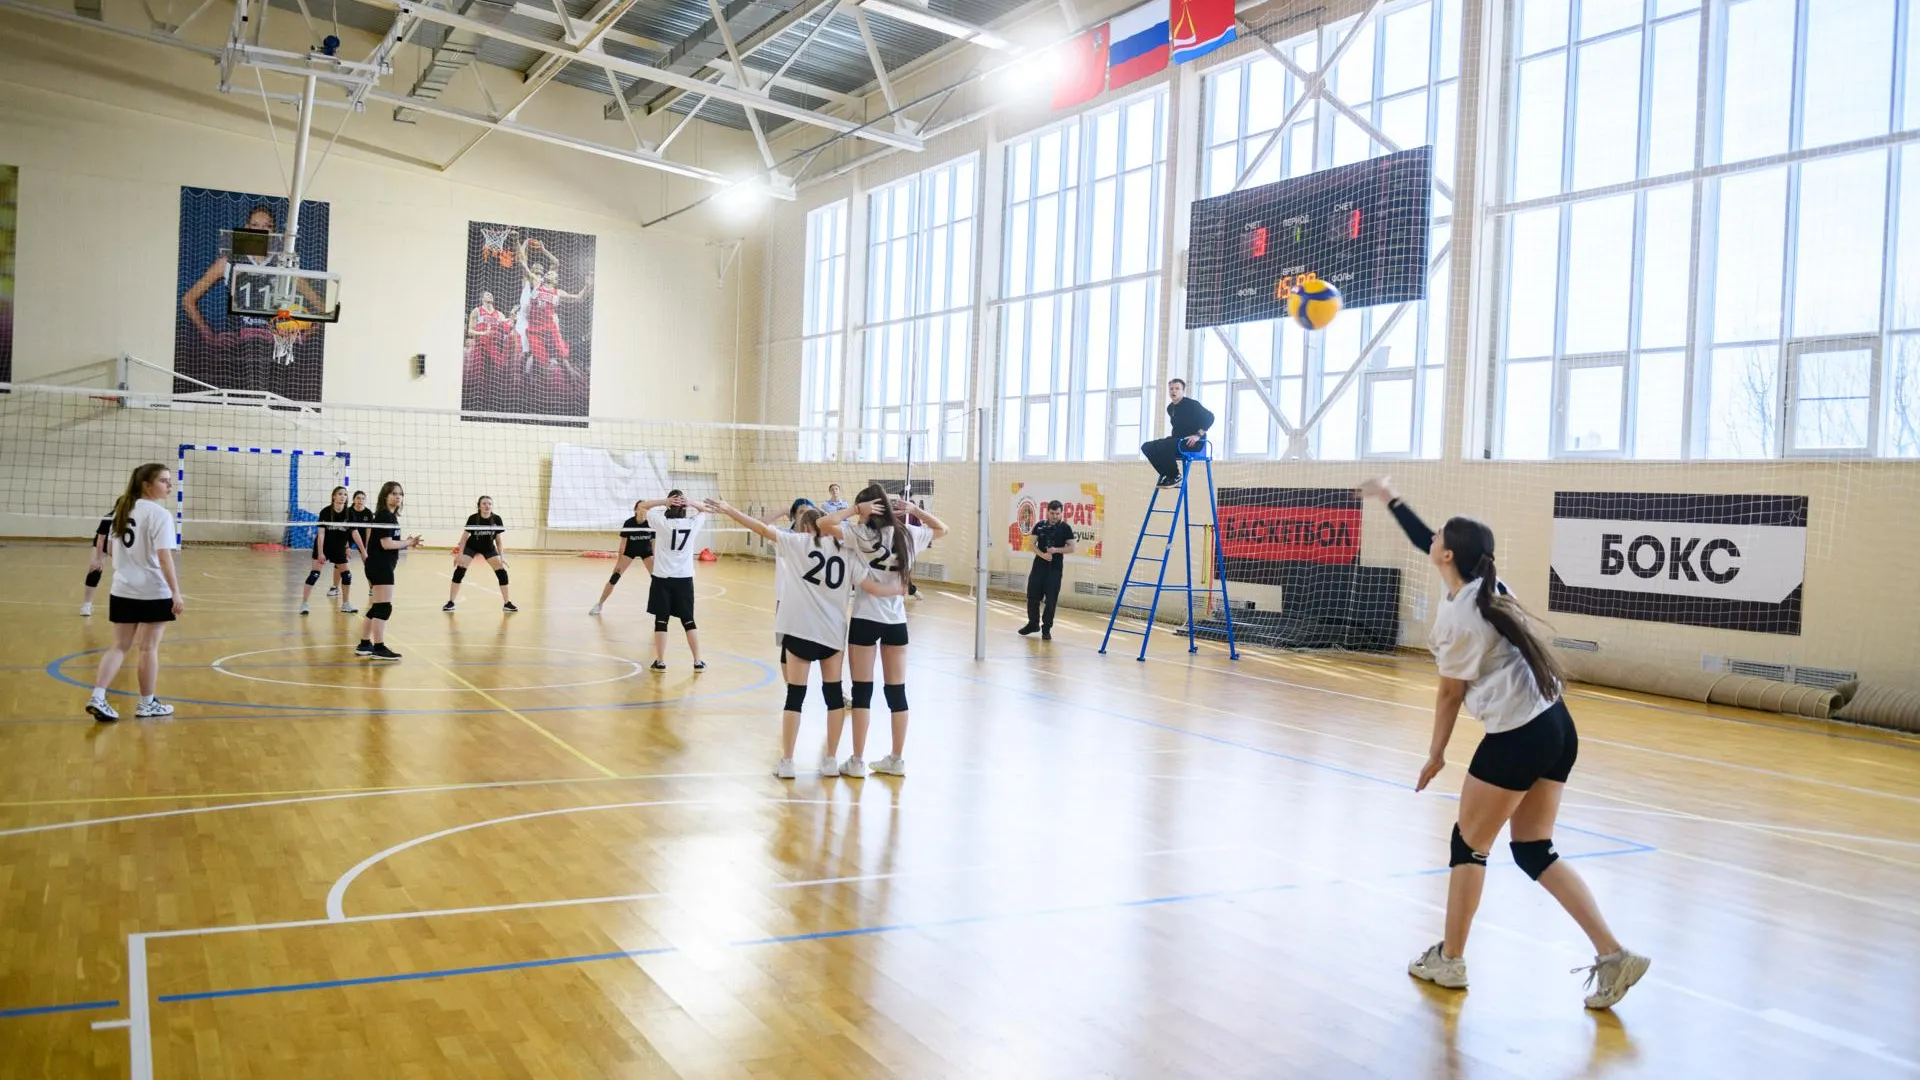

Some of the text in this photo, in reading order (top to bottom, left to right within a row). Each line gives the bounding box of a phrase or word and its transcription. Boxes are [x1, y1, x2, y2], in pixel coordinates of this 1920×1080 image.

[1040, 501, 1097, 526] ПРАТ
[121, 517, 136, 549] 6
[670, 529, 692, 551] 17
[1225, 517, 1352, 547] БАСКЕТБОЛ
[802, 550, 845, 590] 20
[1600, 533, 1741, 584] БОКС
